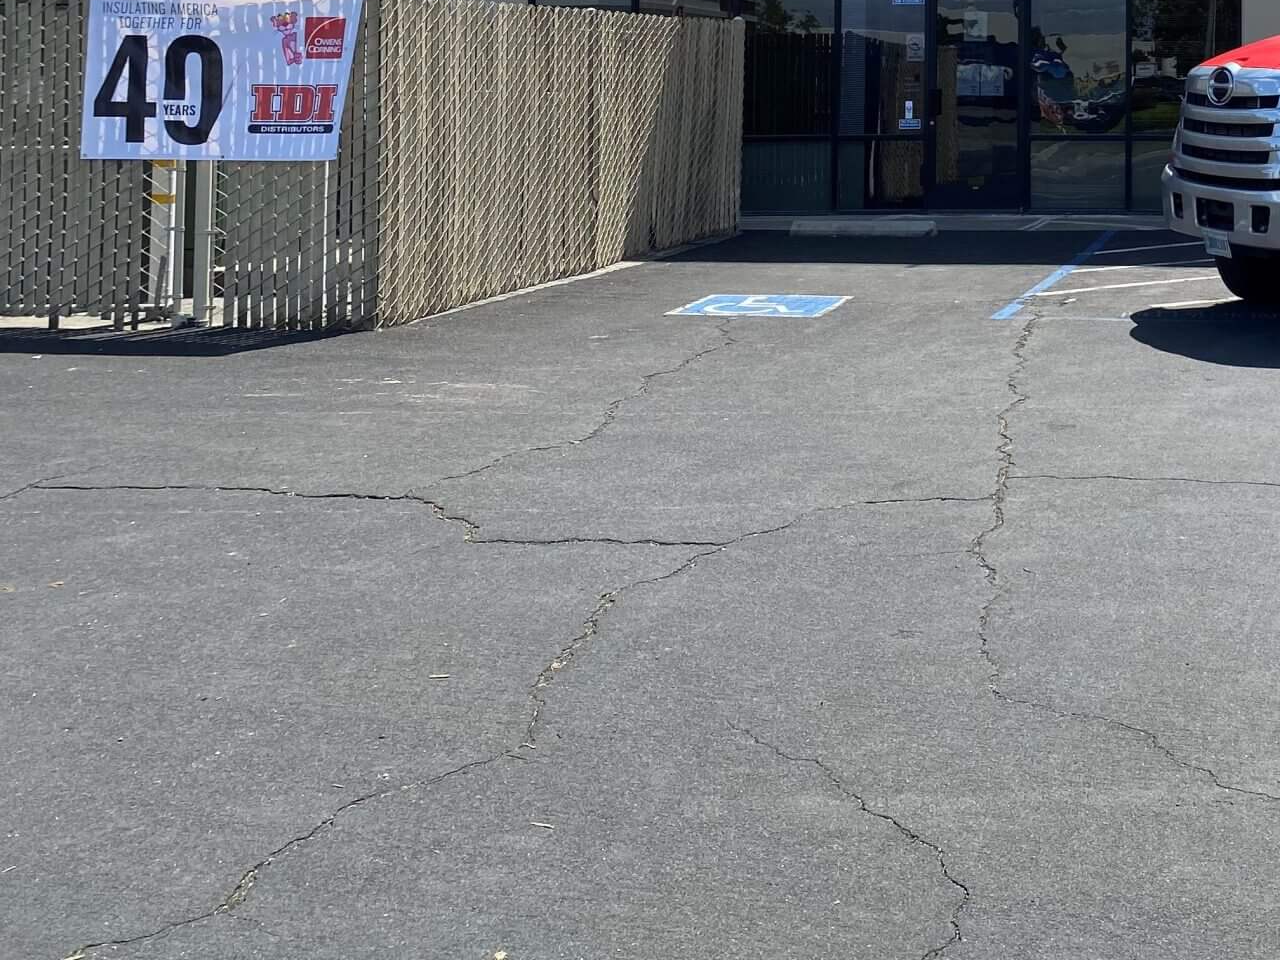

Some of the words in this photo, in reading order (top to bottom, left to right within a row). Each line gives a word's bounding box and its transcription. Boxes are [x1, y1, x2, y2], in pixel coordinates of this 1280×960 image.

[102, 1, 166, 15] INSULATING
[170, 2, 218, 16] AMERICA
[119, 16, 175, 29] TOGETHER
[180, 17, 201, 29] FOR
[93, 35, 223, 146] 40
[163, 104, 196, 116] YEARS
[250, 84, 338, 123] IDI
[260, 125, 325, 133] DISTRIBUTORS
